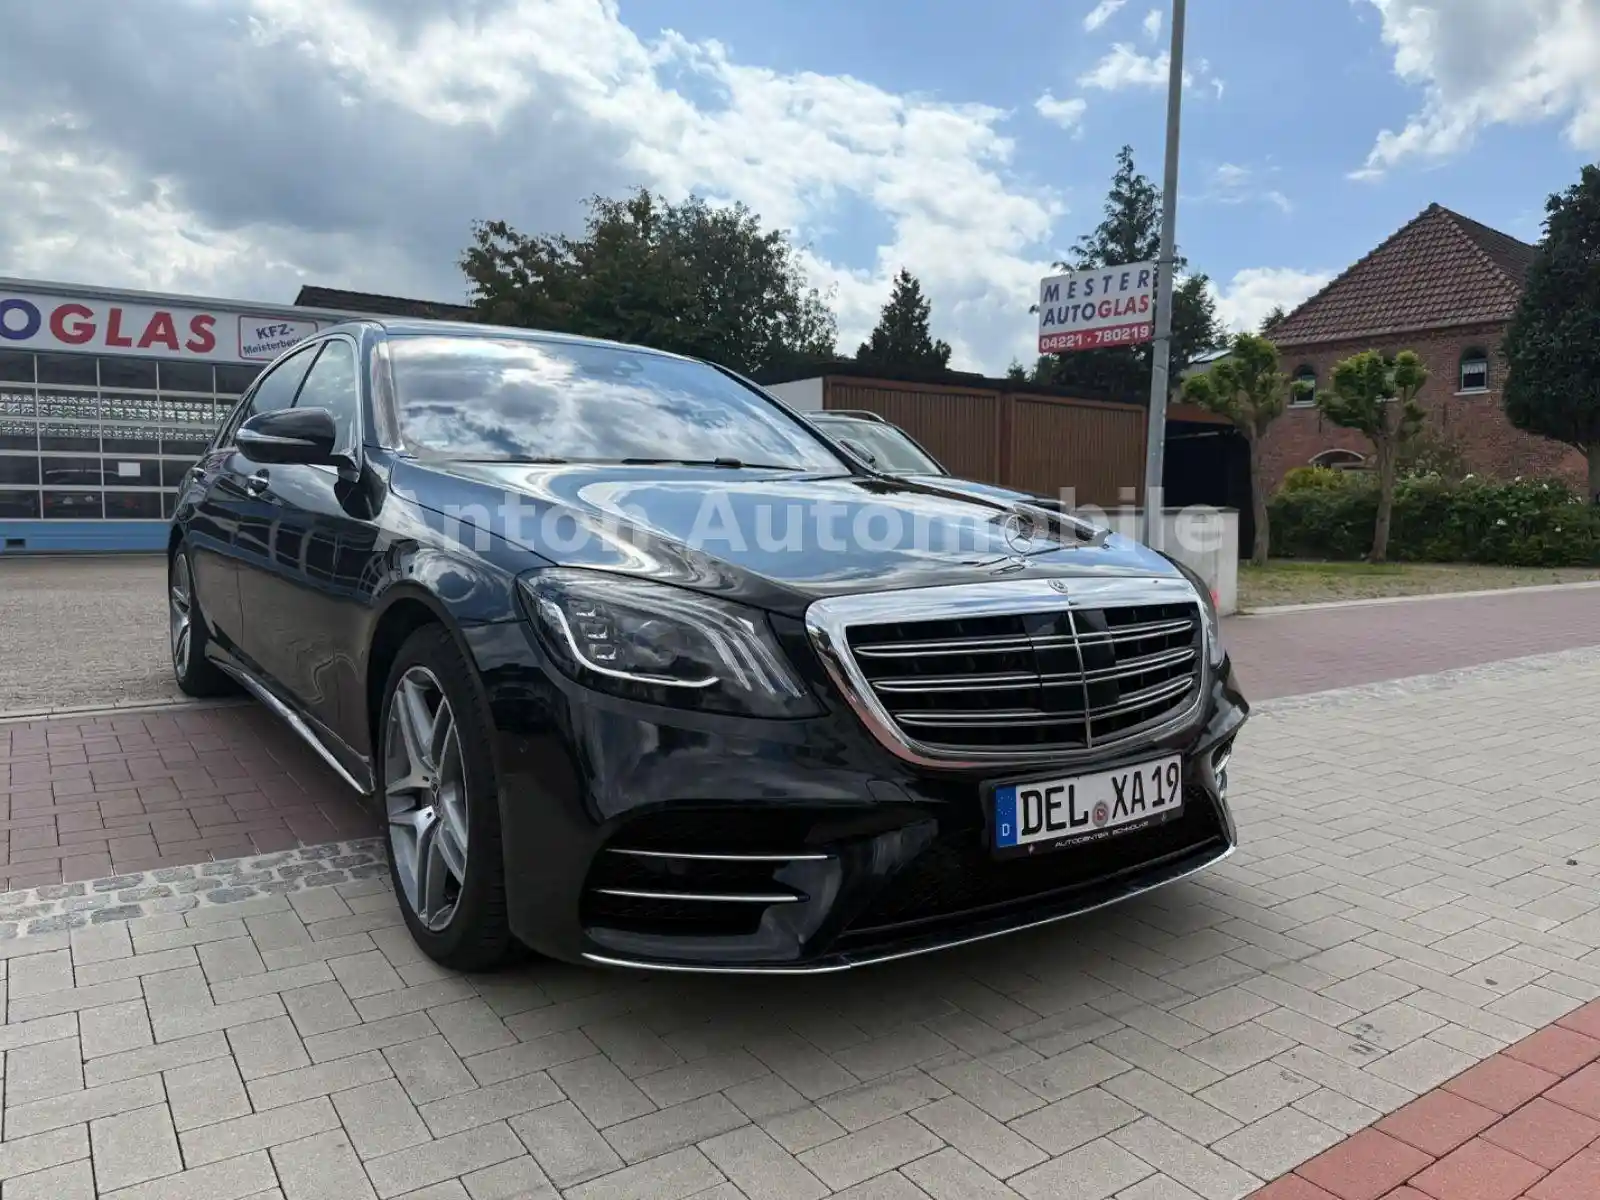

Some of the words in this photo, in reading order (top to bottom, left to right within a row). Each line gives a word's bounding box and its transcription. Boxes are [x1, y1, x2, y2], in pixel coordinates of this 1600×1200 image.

[1043, 269, 1150, 303] MESTER
[0, 299, 217, 353] OGLAS
[1043, 294, 1149, 326] AUTOGLAS
[1041, 334, 1083, 350] 04221
[1094, 325, 1149, 344] 780219
[1020, 784, 1089, 836] DEL
[1001, 823, 1010, 837] D
